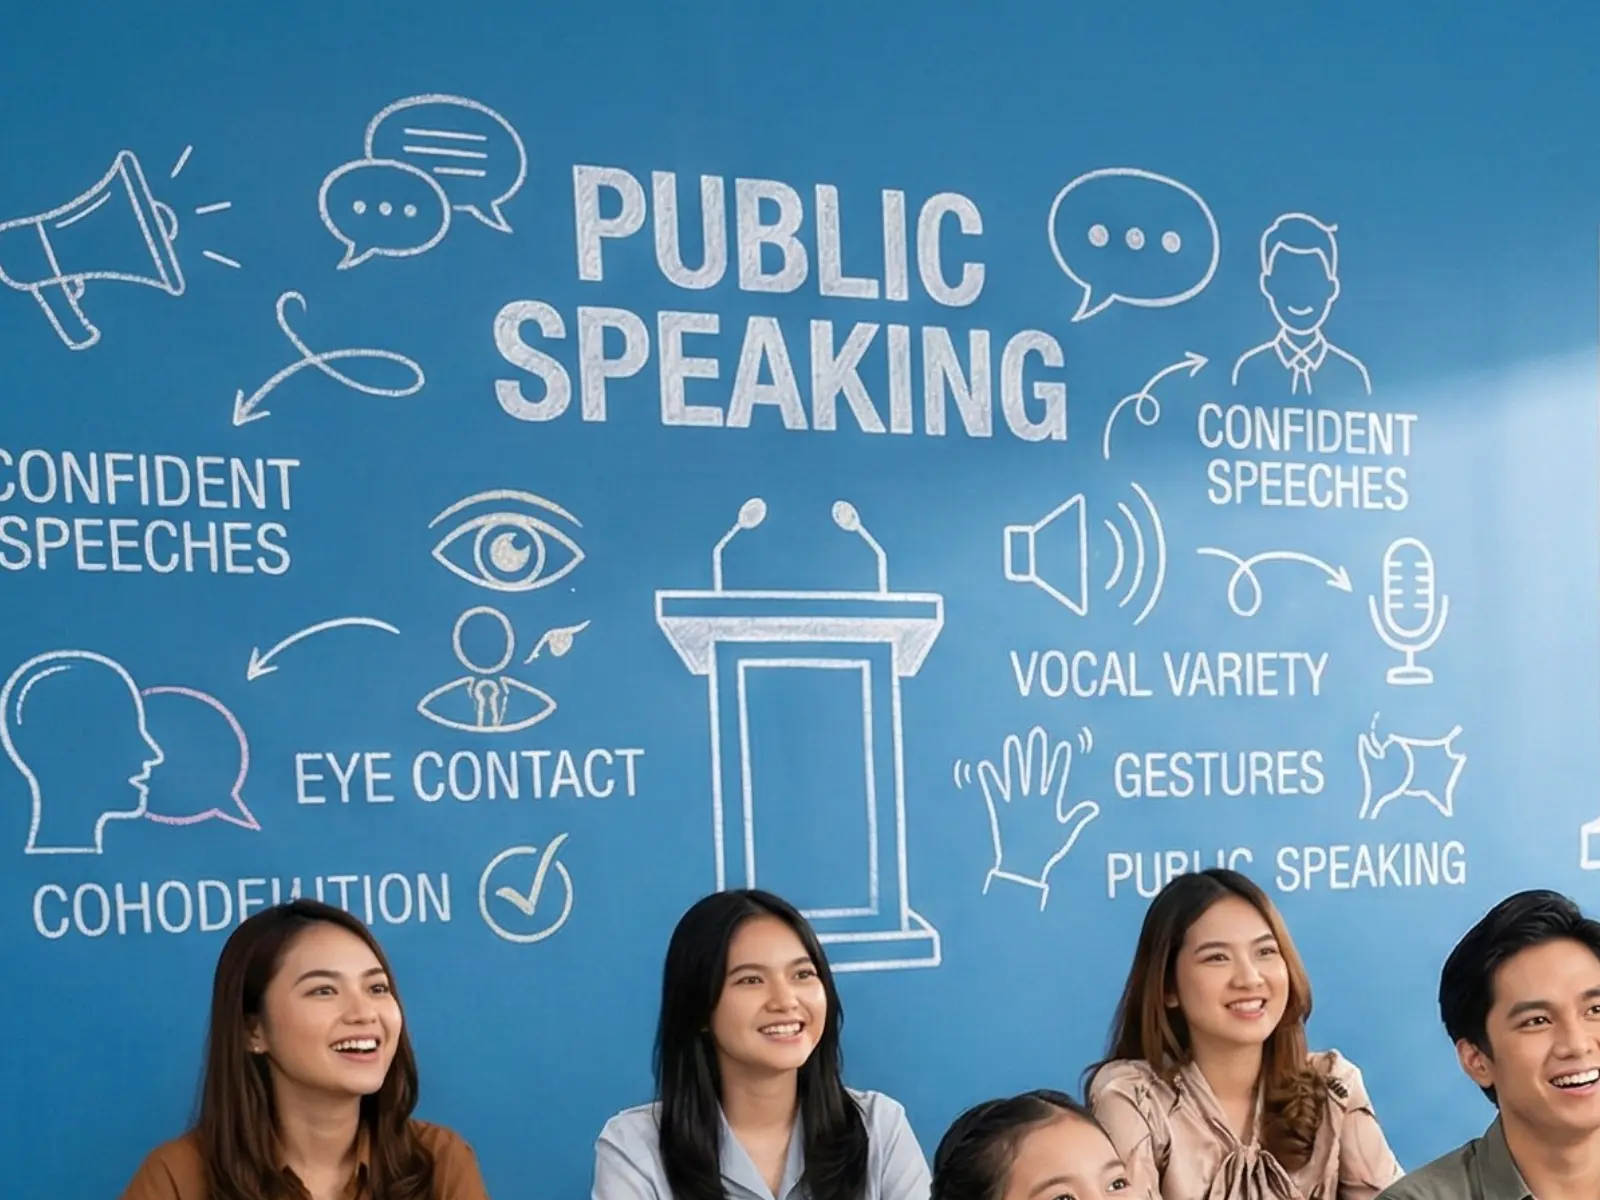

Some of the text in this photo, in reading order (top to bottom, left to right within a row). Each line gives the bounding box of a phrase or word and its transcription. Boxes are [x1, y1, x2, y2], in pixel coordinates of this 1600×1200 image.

[573, 164, 985, 306] PUBLIC
[494, 300, 1067, 441] SPEAKING
[1199, 403, 1417, 457] CONFIDENT
[1208, 459, 1408, 511] SPEECHES
[0, 515, 290, 575] SPEECHES
[1011, 650, 1329, 697] VOCAL VARIETY
[295, 748, 644, 804] EYE CONTACT
[1115, 750, 1325, 798] GESTURES
[1276, 840, 1466, 891] SPEAKING
